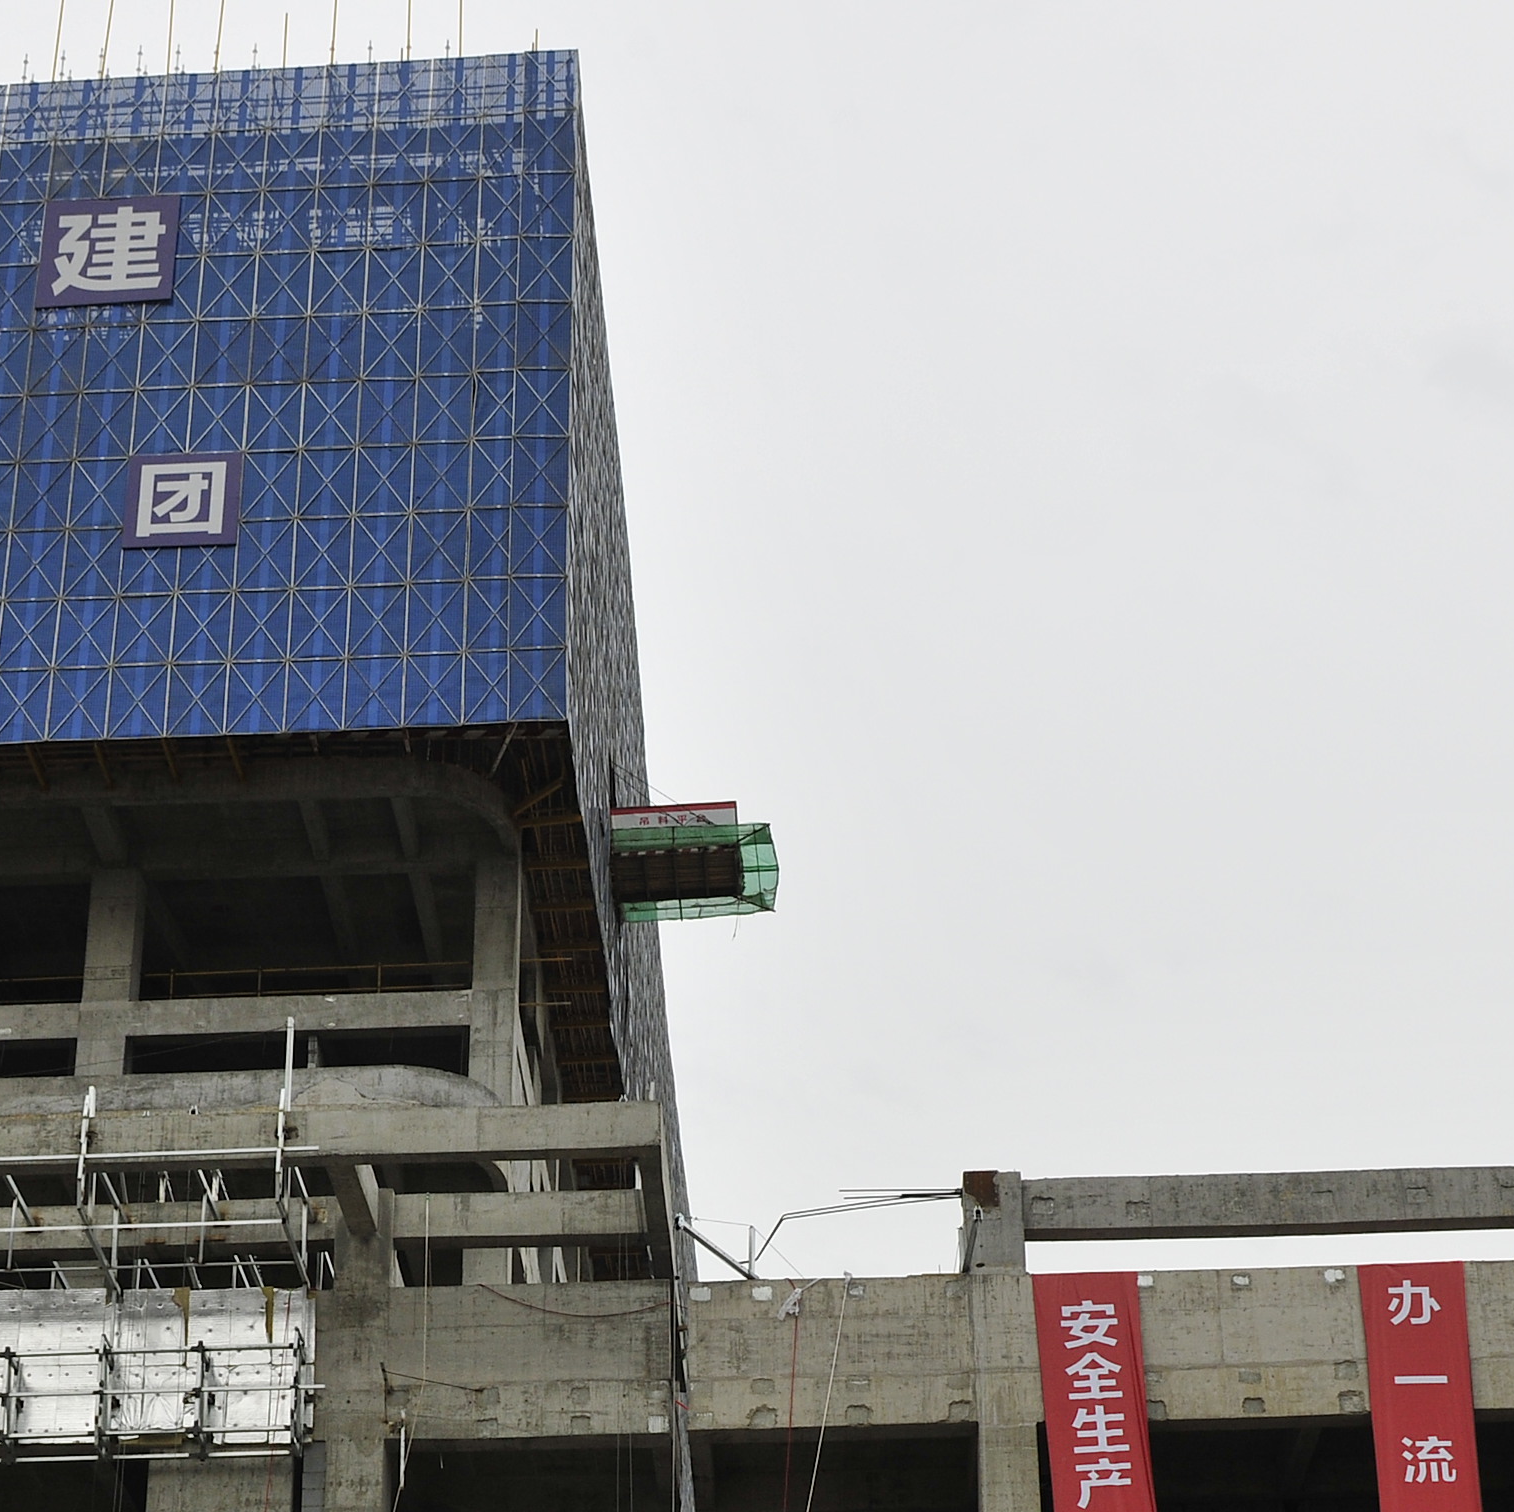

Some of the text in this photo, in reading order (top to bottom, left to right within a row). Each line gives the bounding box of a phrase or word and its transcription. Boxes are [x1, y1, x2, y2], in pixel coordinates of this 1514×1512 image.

[52, 208, 166, 296] 建
[1060, 1299, 1132, 1510] 安全生产
